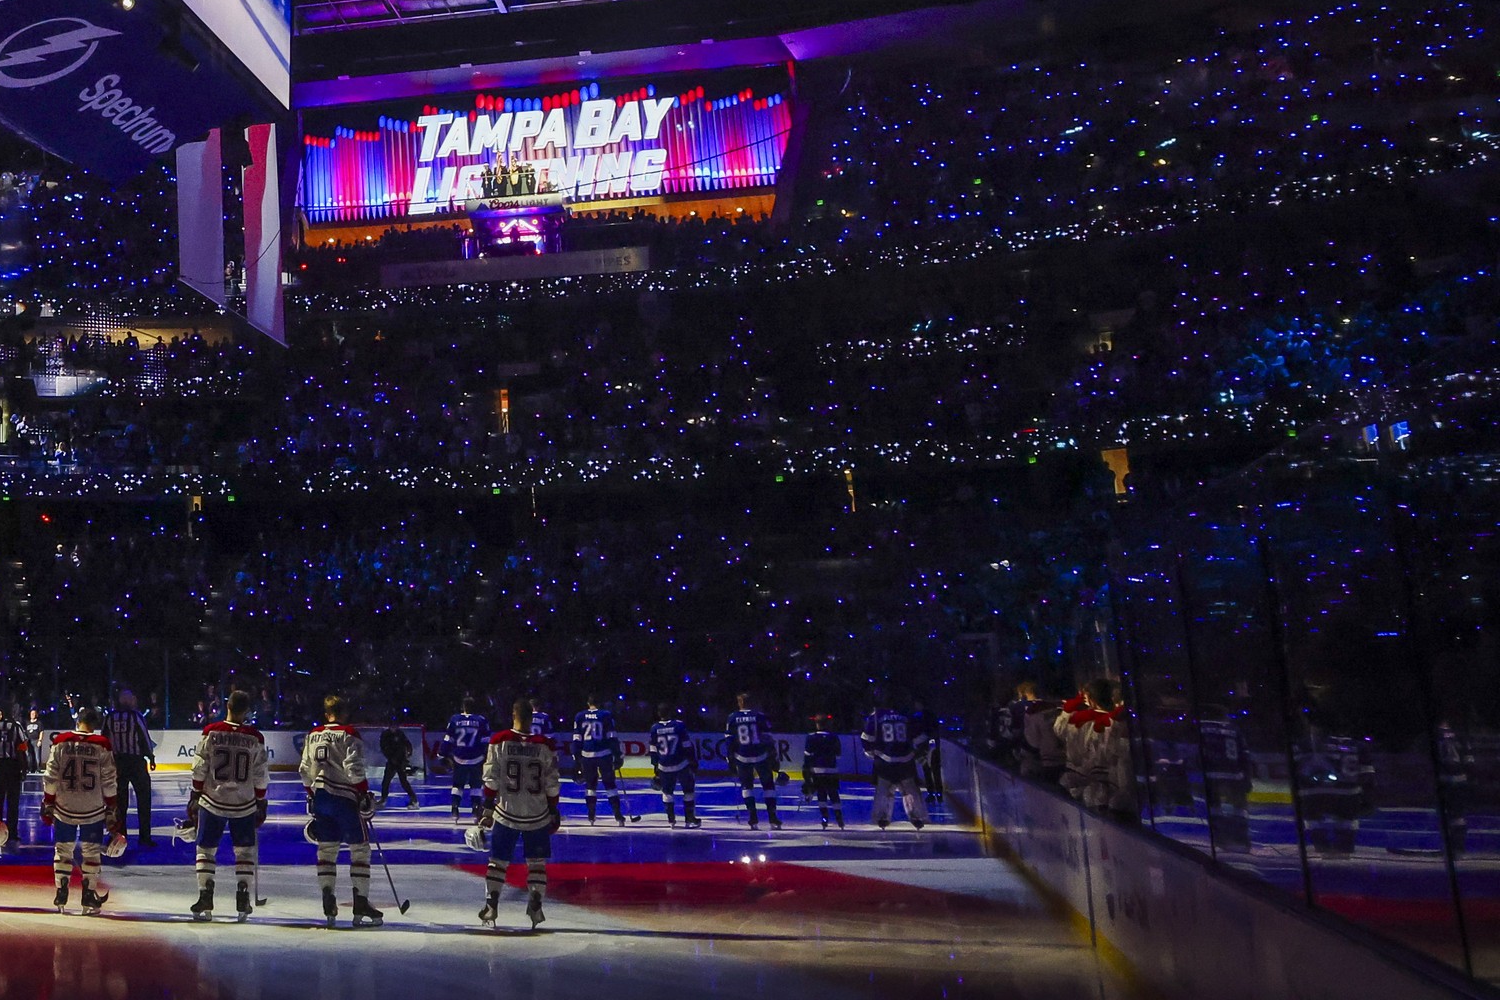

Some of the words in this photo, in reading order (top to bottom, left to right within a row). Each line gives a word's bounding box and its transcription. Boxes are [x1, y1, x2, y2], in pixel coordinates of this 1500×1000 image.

[78, 73, 177, 155] Spectrum
[418, 107, 565, 163] TAMPA
[573, 97, 676, 149] BAY
[488, 198, 520, 210] Coors
[455, 726, 479, 747] 27
[582, 720, 604, 741] 20
[737, 723, 760, 745] 81
[656, 734, 680, 756] 37
[62, 757, 97, 792] 45
[213, 747, 250, 782] 20
[506, 760, 542, 795] 93
